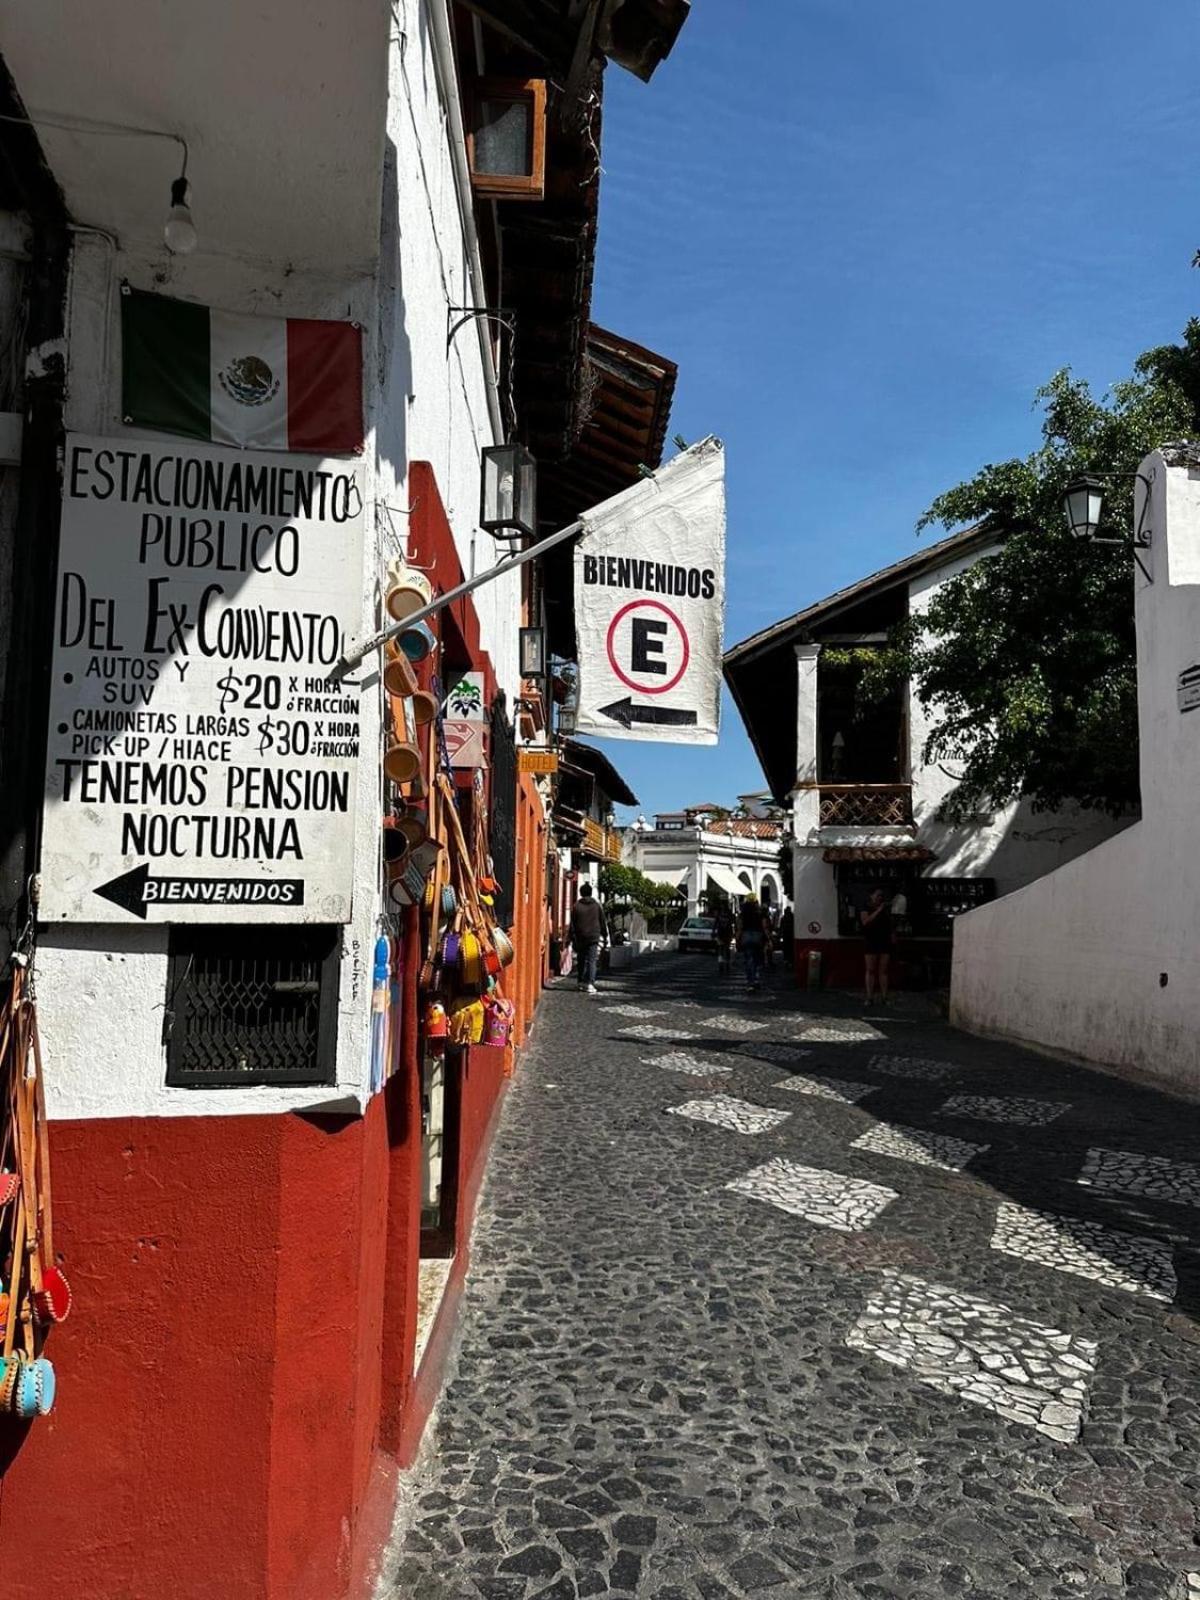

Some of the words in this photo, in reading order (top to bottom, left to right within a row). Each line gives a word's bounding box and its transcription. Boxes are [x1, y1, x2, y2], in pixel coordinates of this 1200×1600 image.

[70, 447, 349, 523] ESTACIONAMIENTO
[139, 513, 300, 577] PUBLICO
[583, 554, 715, 600] BIENVENIDOS
[631, 618, 667, 675] E
[85, 656, 160, 681] AUTOS
[174, 660, 190, 682] Y
[305, 676, 342, 694] HORA
[103, 681, 155, 706] SUV
[216, 666, 281, 715] $20
[73, 708, 177, 734] CAMIONETAS
[186, 714, 250, 737] LARGAS
[254, 714, 310, 757] $30
[328, 722, 360, 738] HORA
[72, 734, 150, 757] PICK-UP
[521, 755, 554, 769] HOTEL
[56, 759, 207, 806] TENEMOS
[227, 766, 349, 812] PENSION
[121, 813, 304, 860] NOCTURNA
[142, 881, 296, 901] BIENVENIDOS
